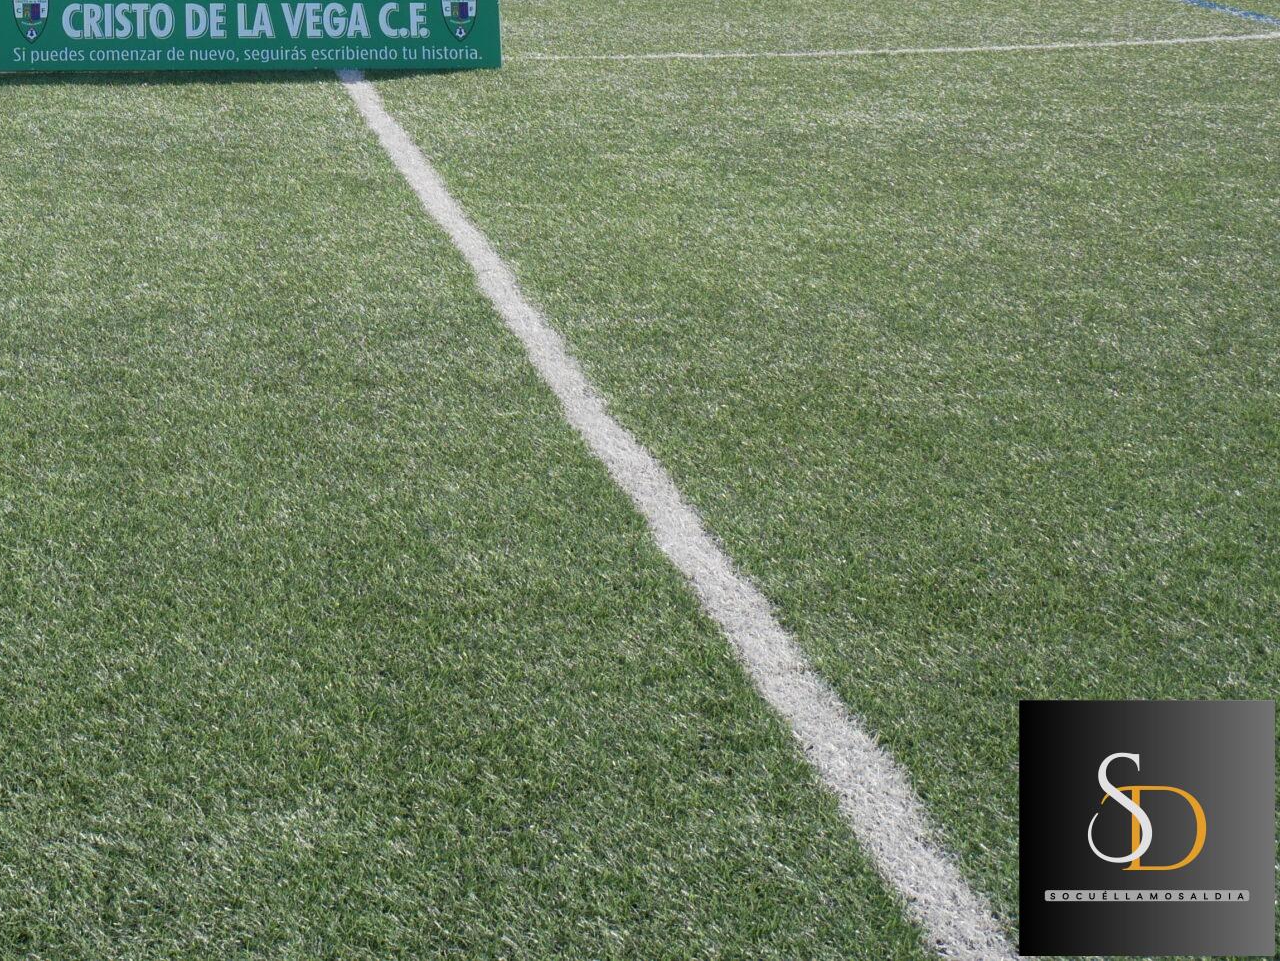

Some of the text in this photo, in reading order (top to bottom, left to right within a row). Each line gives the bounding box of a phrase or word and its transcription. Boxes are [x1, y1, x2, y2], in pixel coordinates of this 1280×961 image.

[62, 2, 431, 39] CRISTO DE LA VEGA C.F.
[13, 45, 483, 63] Si puedes comenzar de nuevo, seguirás escribiendo tu historia.
